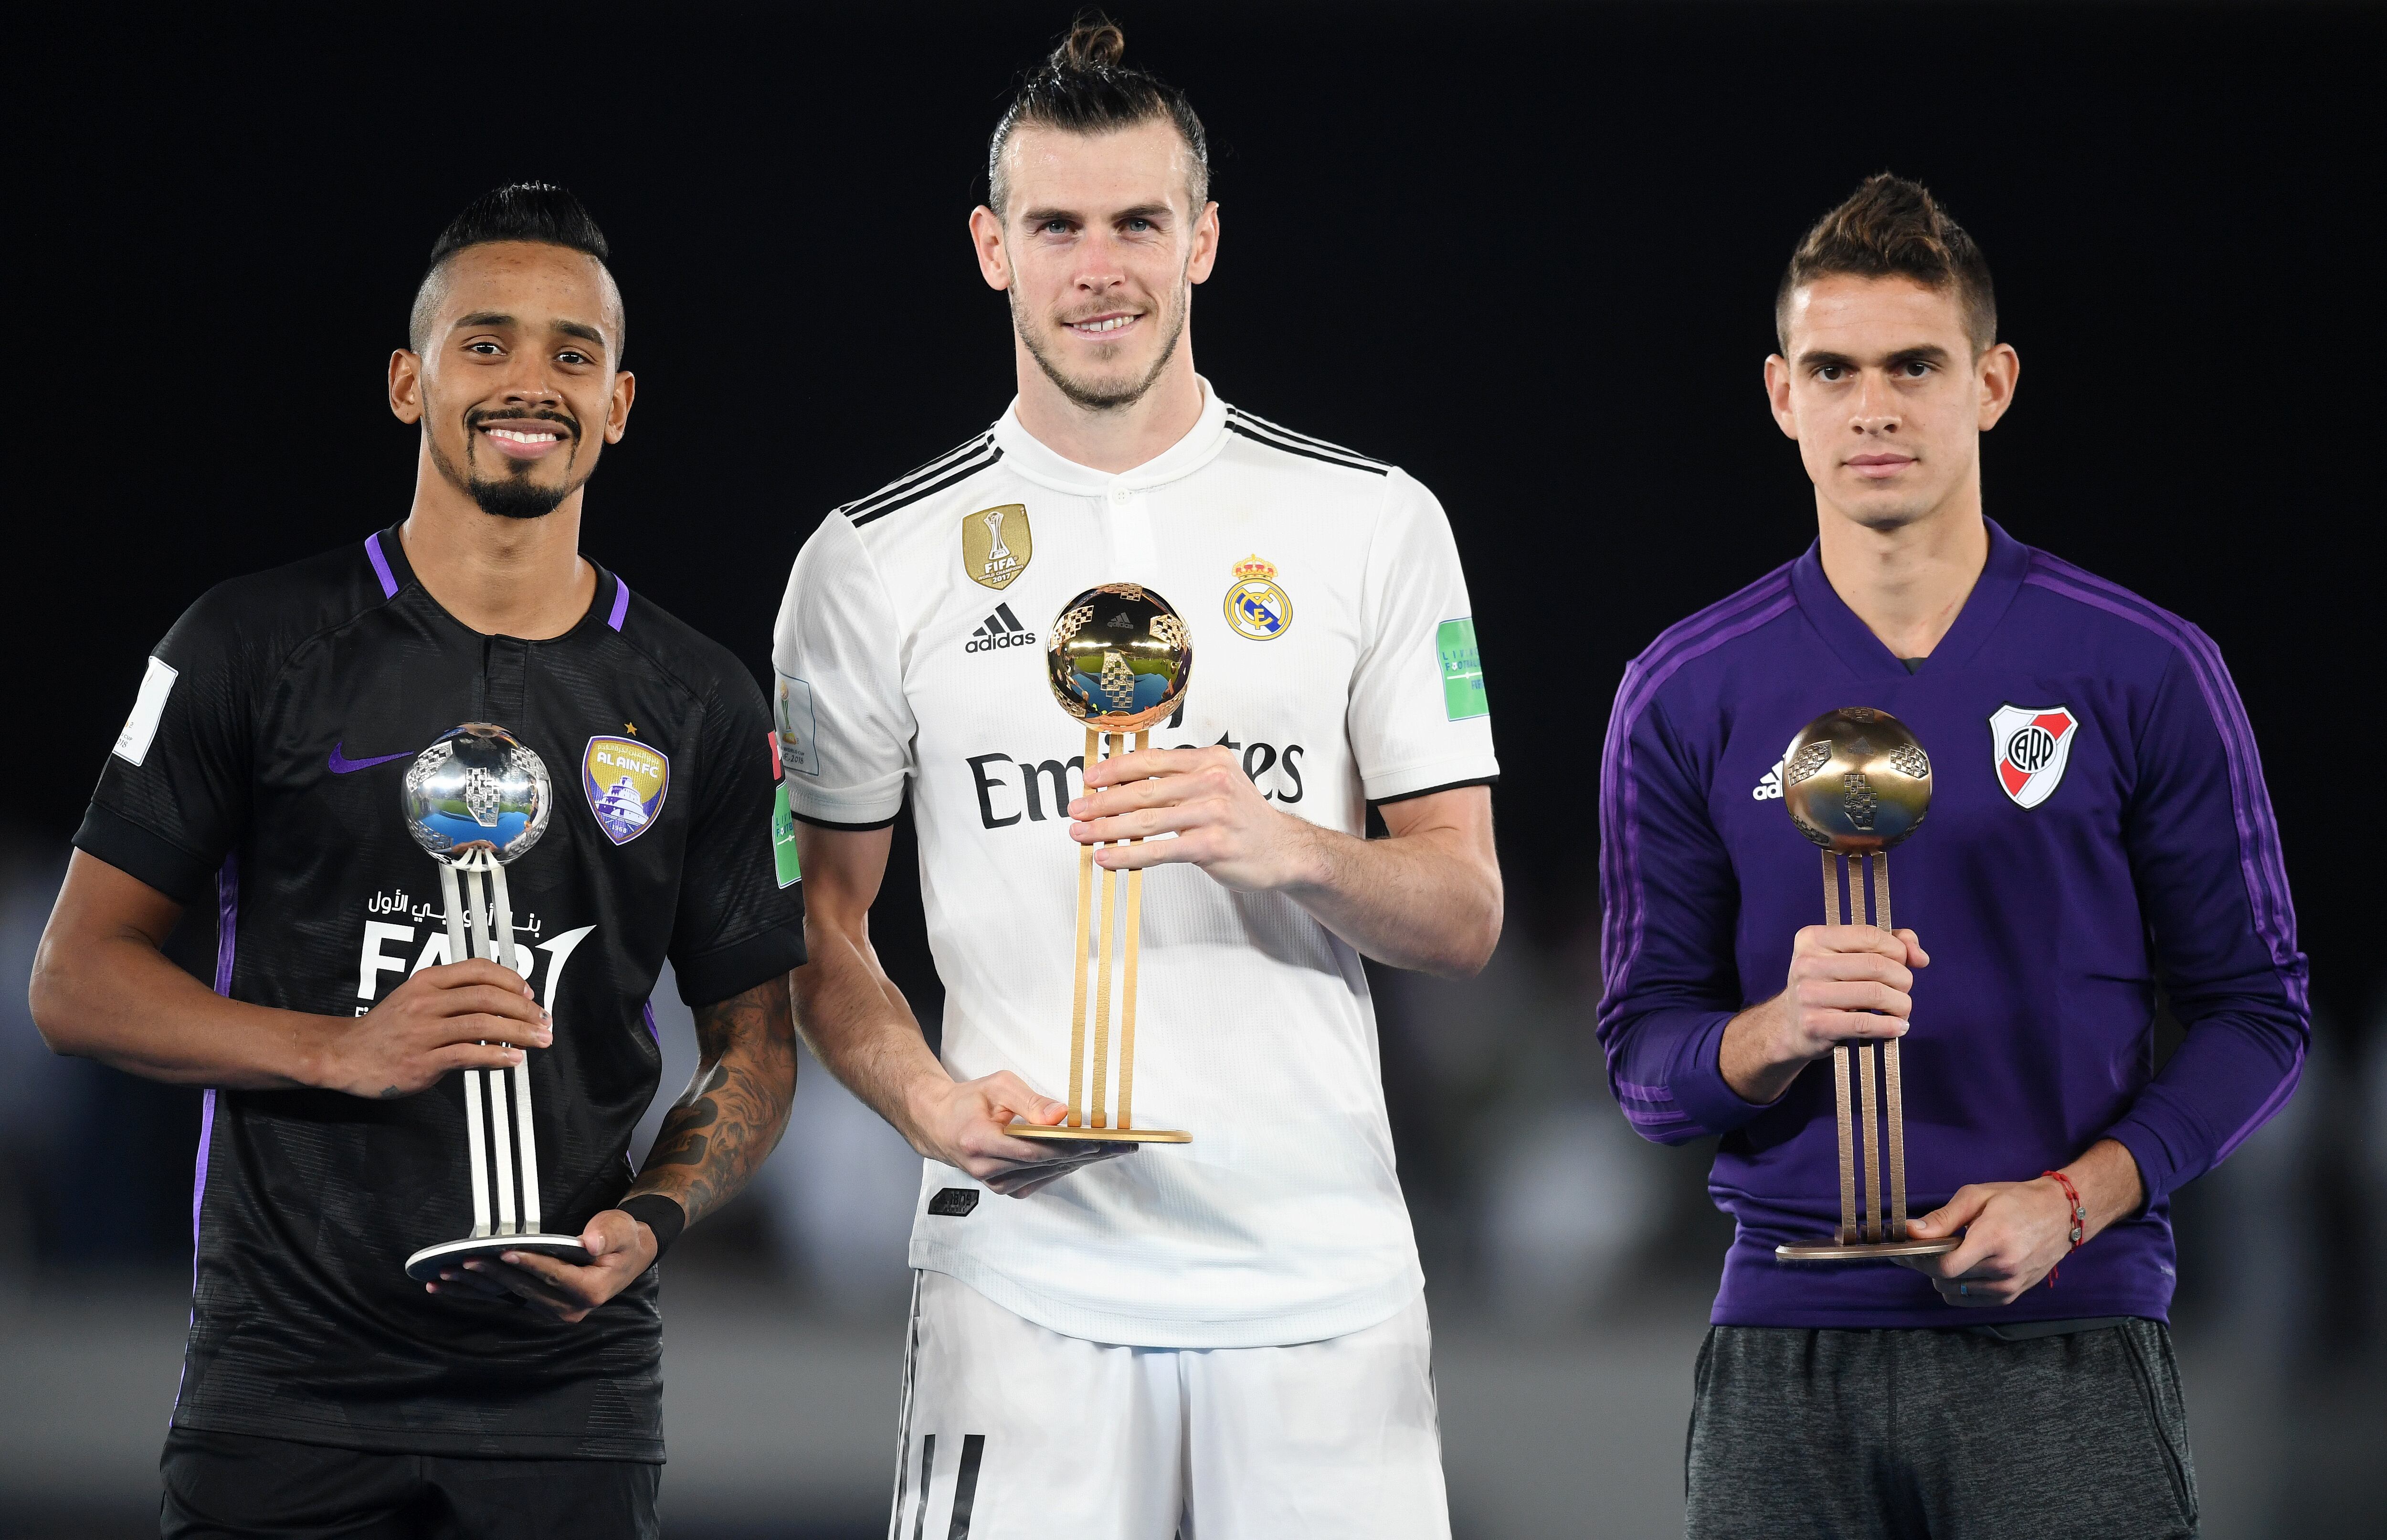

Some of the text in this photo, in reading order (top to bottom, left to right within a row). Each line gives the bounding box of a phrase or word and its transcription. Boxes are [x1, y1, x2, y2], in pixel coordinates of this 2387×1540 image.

[985, 557, 1016, 574] FIFA
[996, 564, 1024, 575] CHAMPIONS
[993, 573, 1011, 583] 2017
[965, 633, 1036, 653] adidas
[597, 752, 658, 778] AL AIN FC
[791, 755, 803, 764] 2018
[612, 824, 626, 833] 1968
[369, 889, 409, 914] الأول
